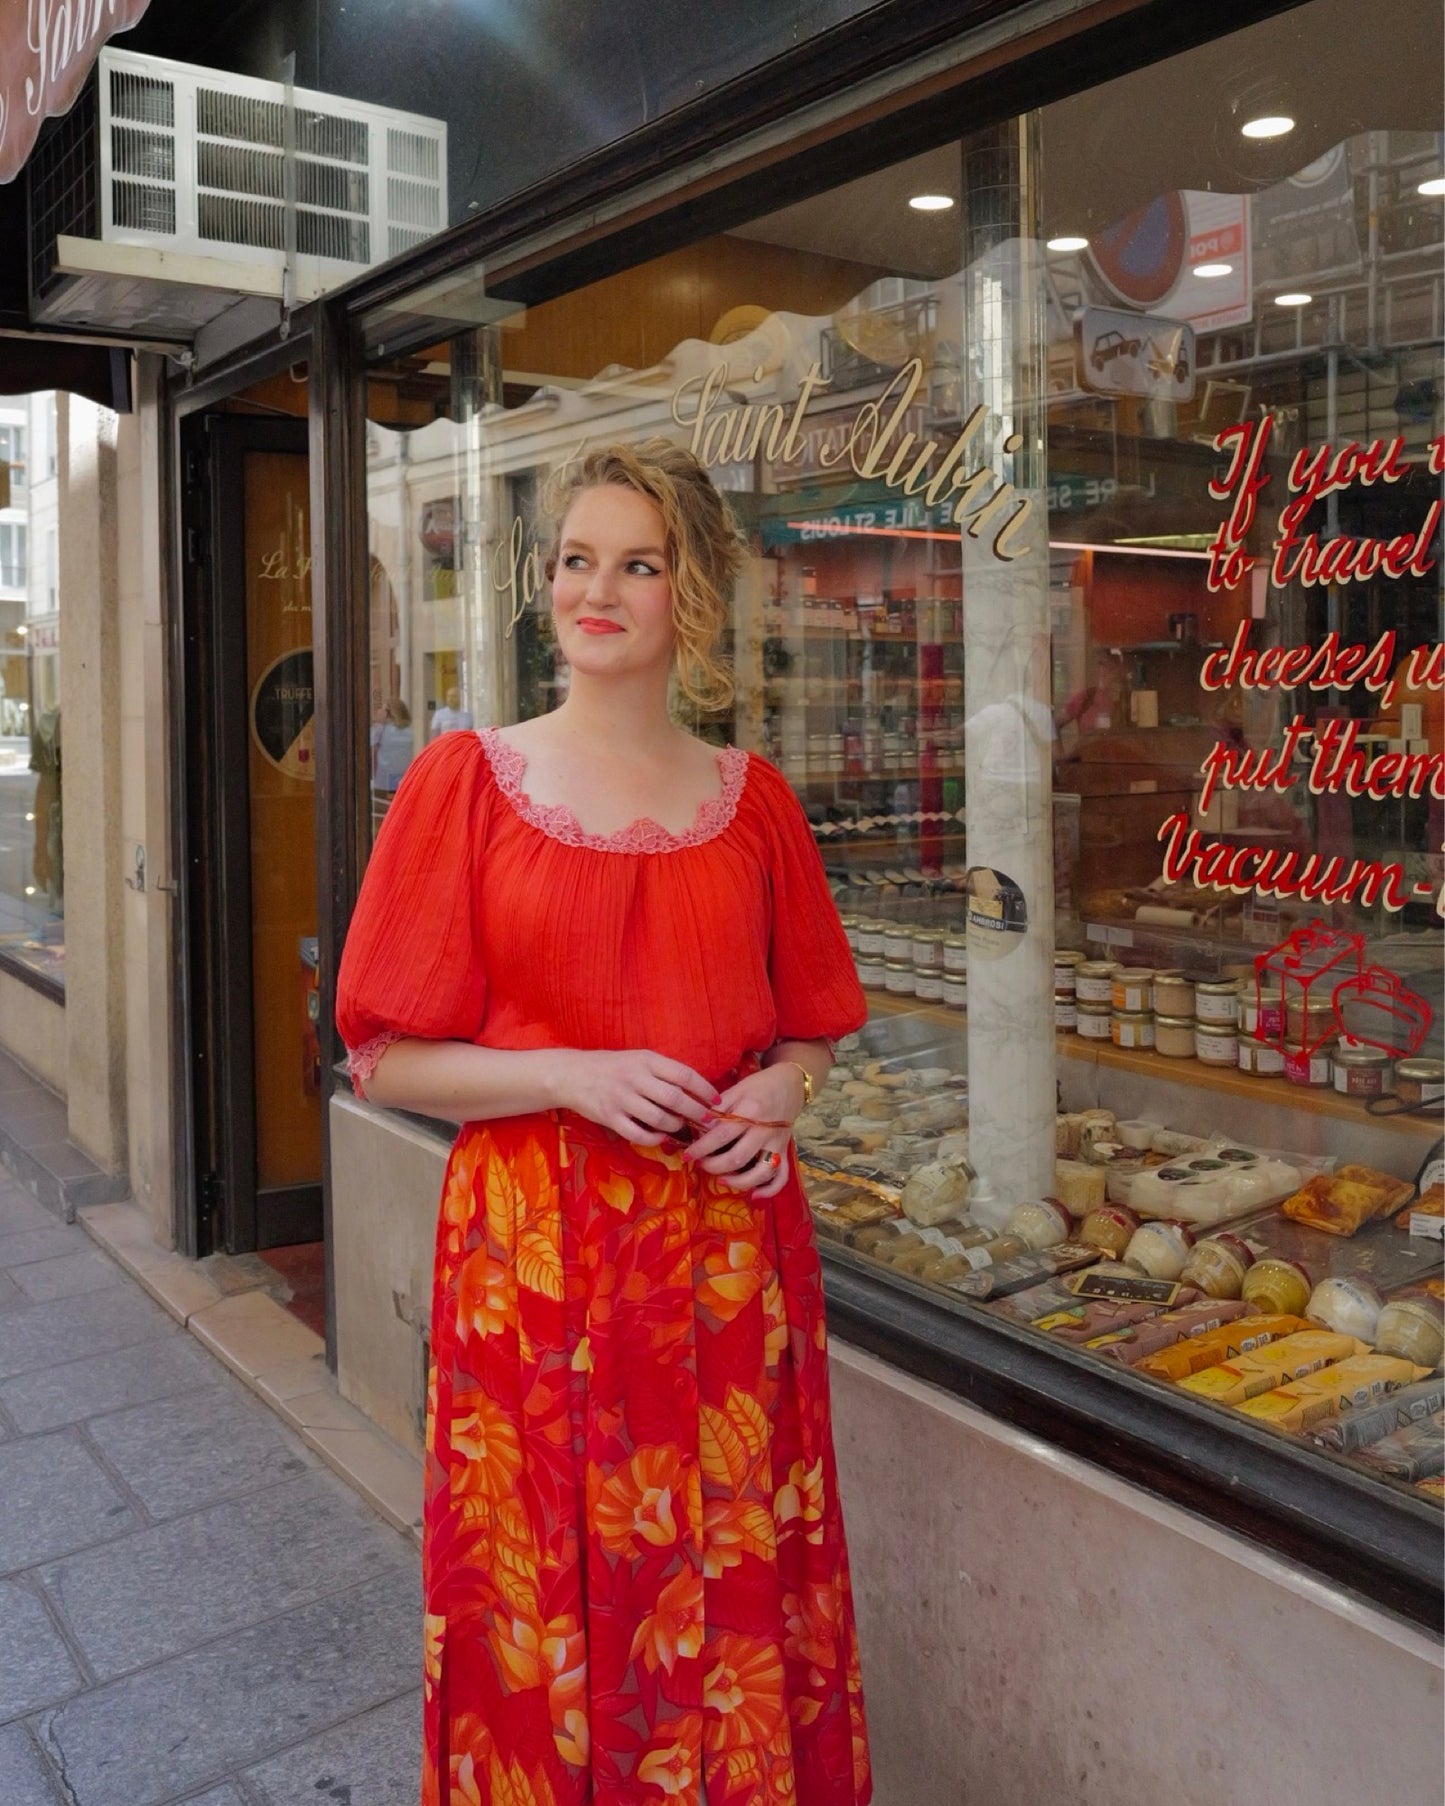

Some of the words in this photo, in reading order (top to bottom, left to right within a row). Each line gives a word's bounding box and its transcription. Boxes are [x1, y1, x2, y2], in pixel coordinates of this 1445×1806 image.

[671, 361, 831, 469] Saint
[820, 358, 1034, 563] Aubin
[1207, 413, 1274, 548] If
[1278, 436, 1410, 540] you
[257, 549, 289, 580] La
[492, 515, 547, 638] La
[1207, 520, 1254, 593] to
[1271, 499, 1444, 590] travel
[1198, 714, 1313, 816] put
[1308, 718, 1445, 800] them
